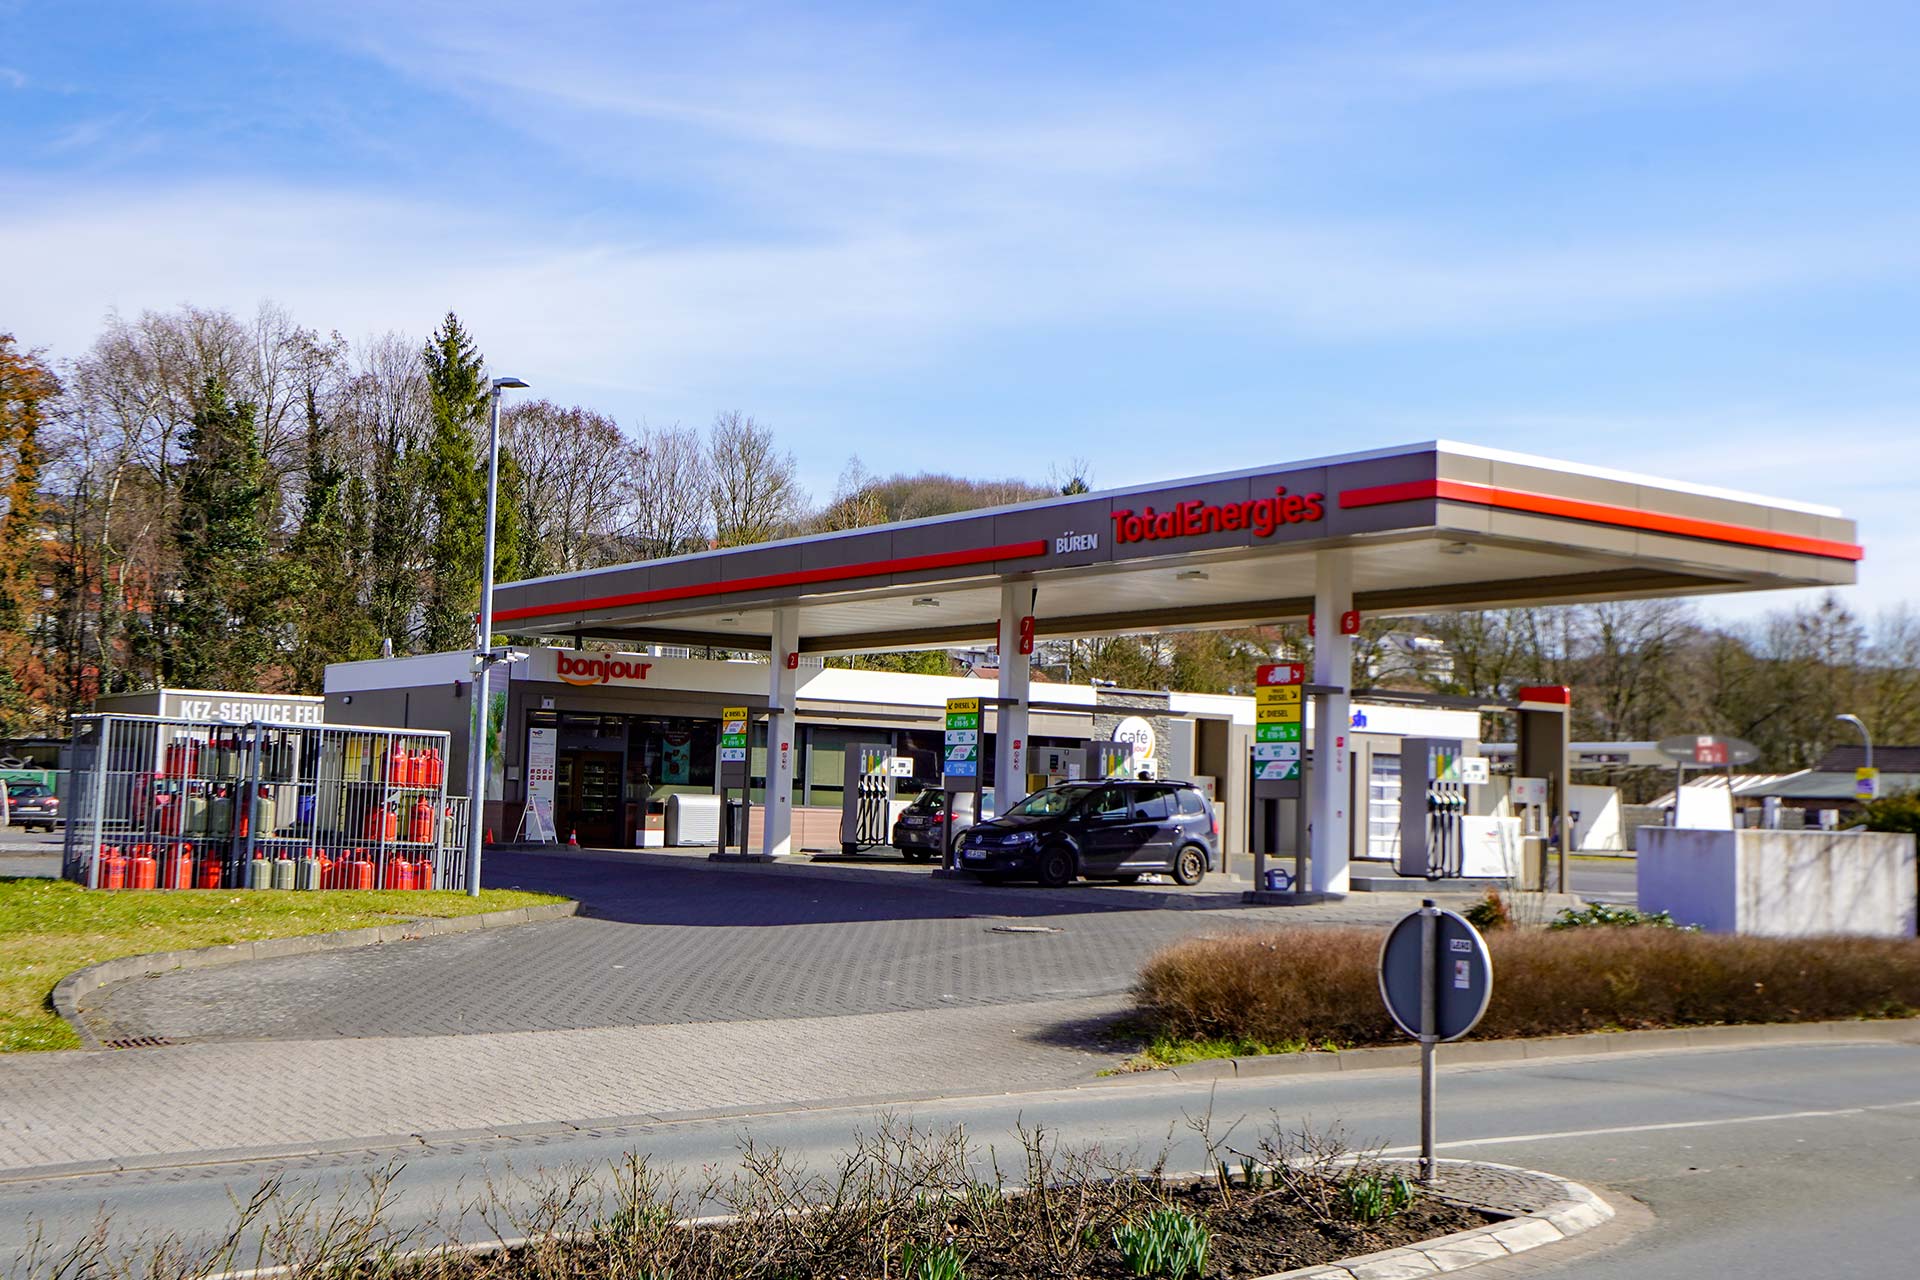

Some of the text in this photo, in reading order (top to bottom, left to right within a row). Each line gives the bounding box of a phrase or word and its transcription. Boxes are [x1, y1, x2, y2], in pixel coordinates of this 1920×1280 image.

[1111, 486, 1326, 544] TotalEnergies
[1056, 531, 1098, 554] BÜREN
[1346, 616, 1354, 629] 6
[557, 651, 653, 684] bonjour
[181, 700, 292, 722] KFZ-SERVICE
[1120, 729, 1148, 744] café
